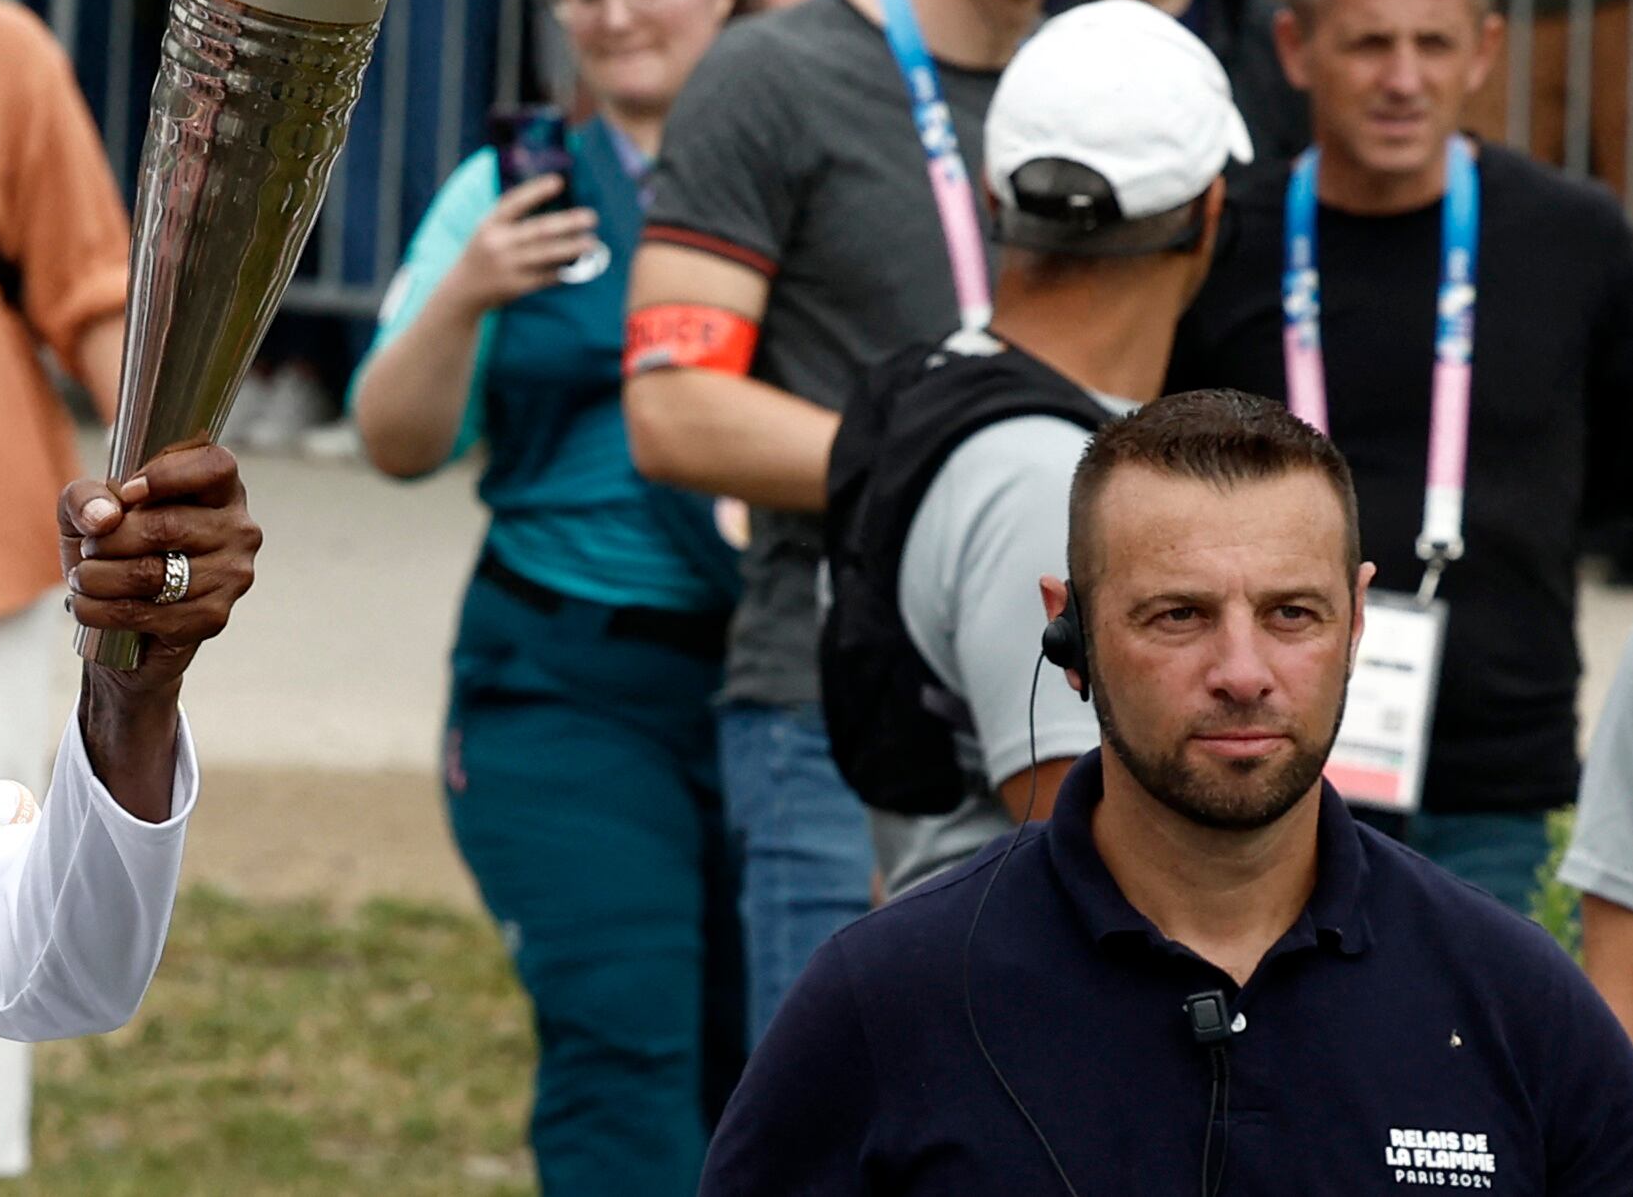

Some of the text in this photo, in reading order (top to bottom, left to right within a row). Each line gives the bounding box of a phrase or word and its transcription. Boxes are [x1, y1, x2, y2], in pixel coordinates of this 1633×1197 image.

[1390, 1128, 1488, 1152] RELAIS DE
[1385, 1146, 1496, 1173] LA FLAMME
[1395, 1169, 1492, 1189] PARIS 2024
